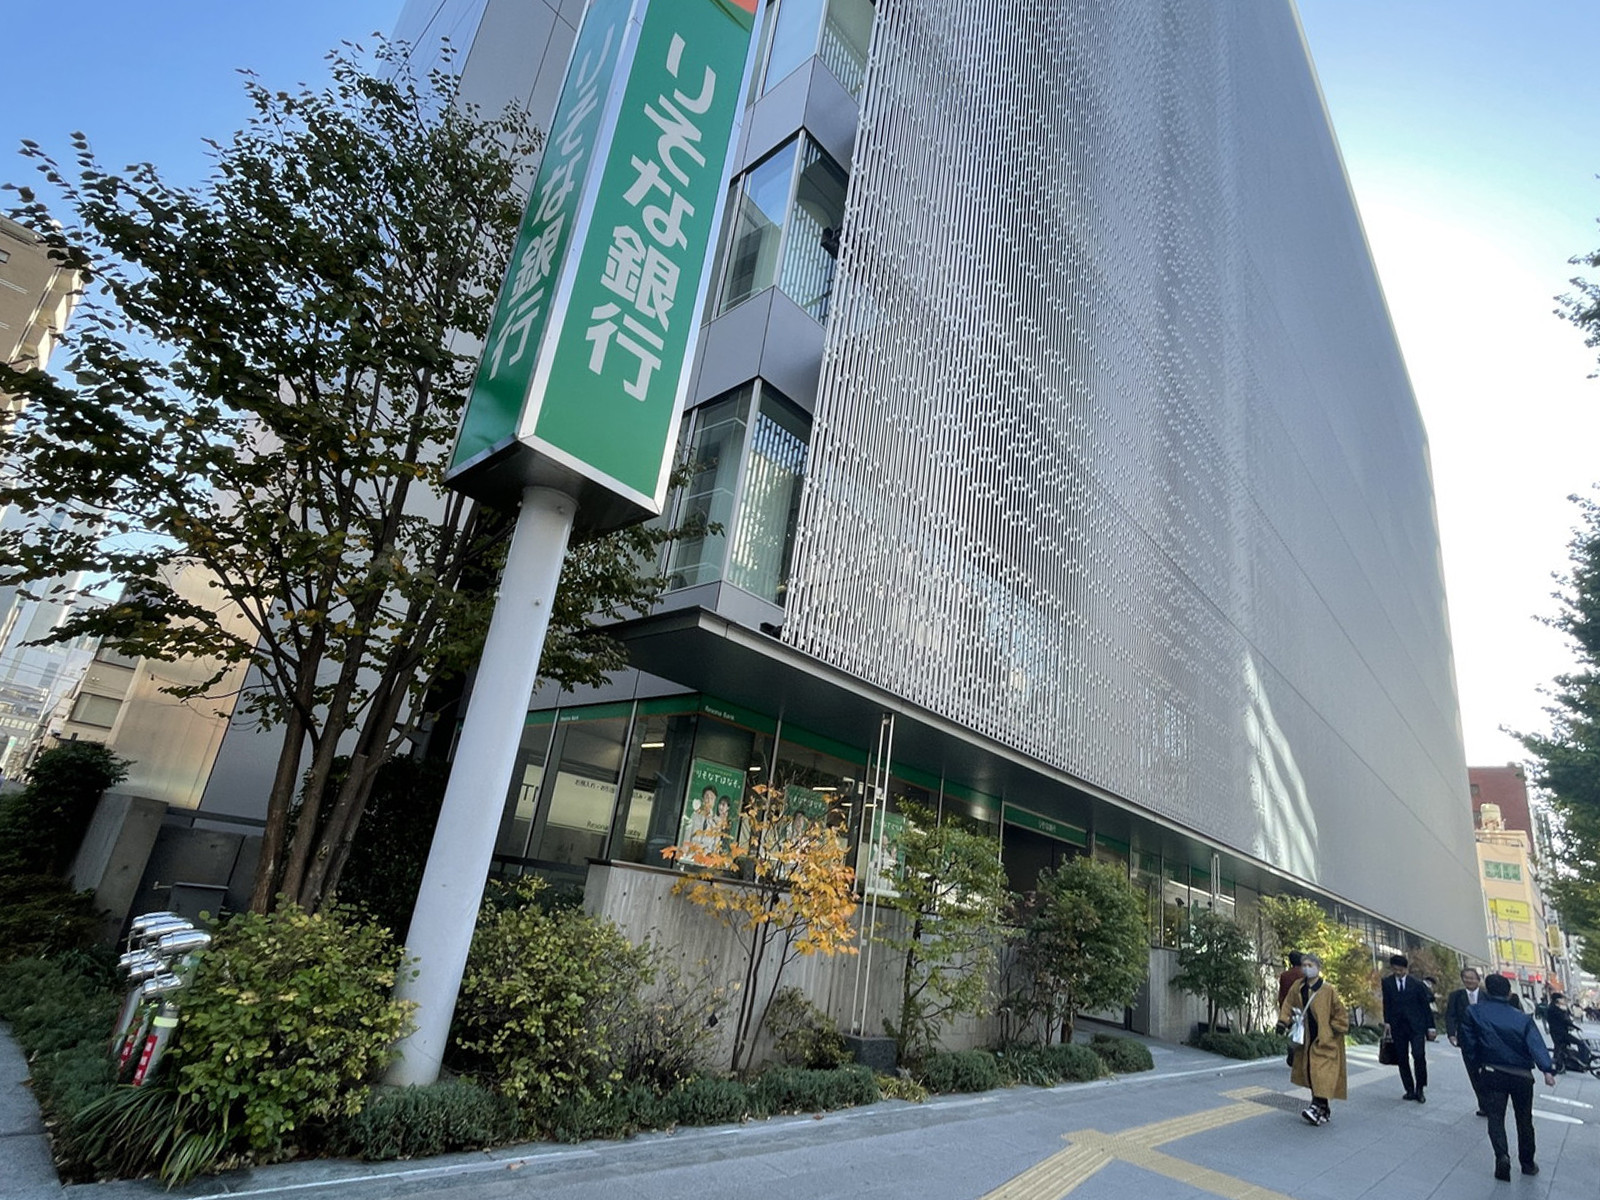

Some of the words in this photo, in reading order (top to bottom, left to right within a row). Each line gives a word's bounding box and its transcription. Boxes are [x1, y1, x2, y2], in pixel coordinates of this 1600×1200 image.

[489, 22, 616, 381] りそな銀行
[585, 32, 717, 402] りそな銀行
